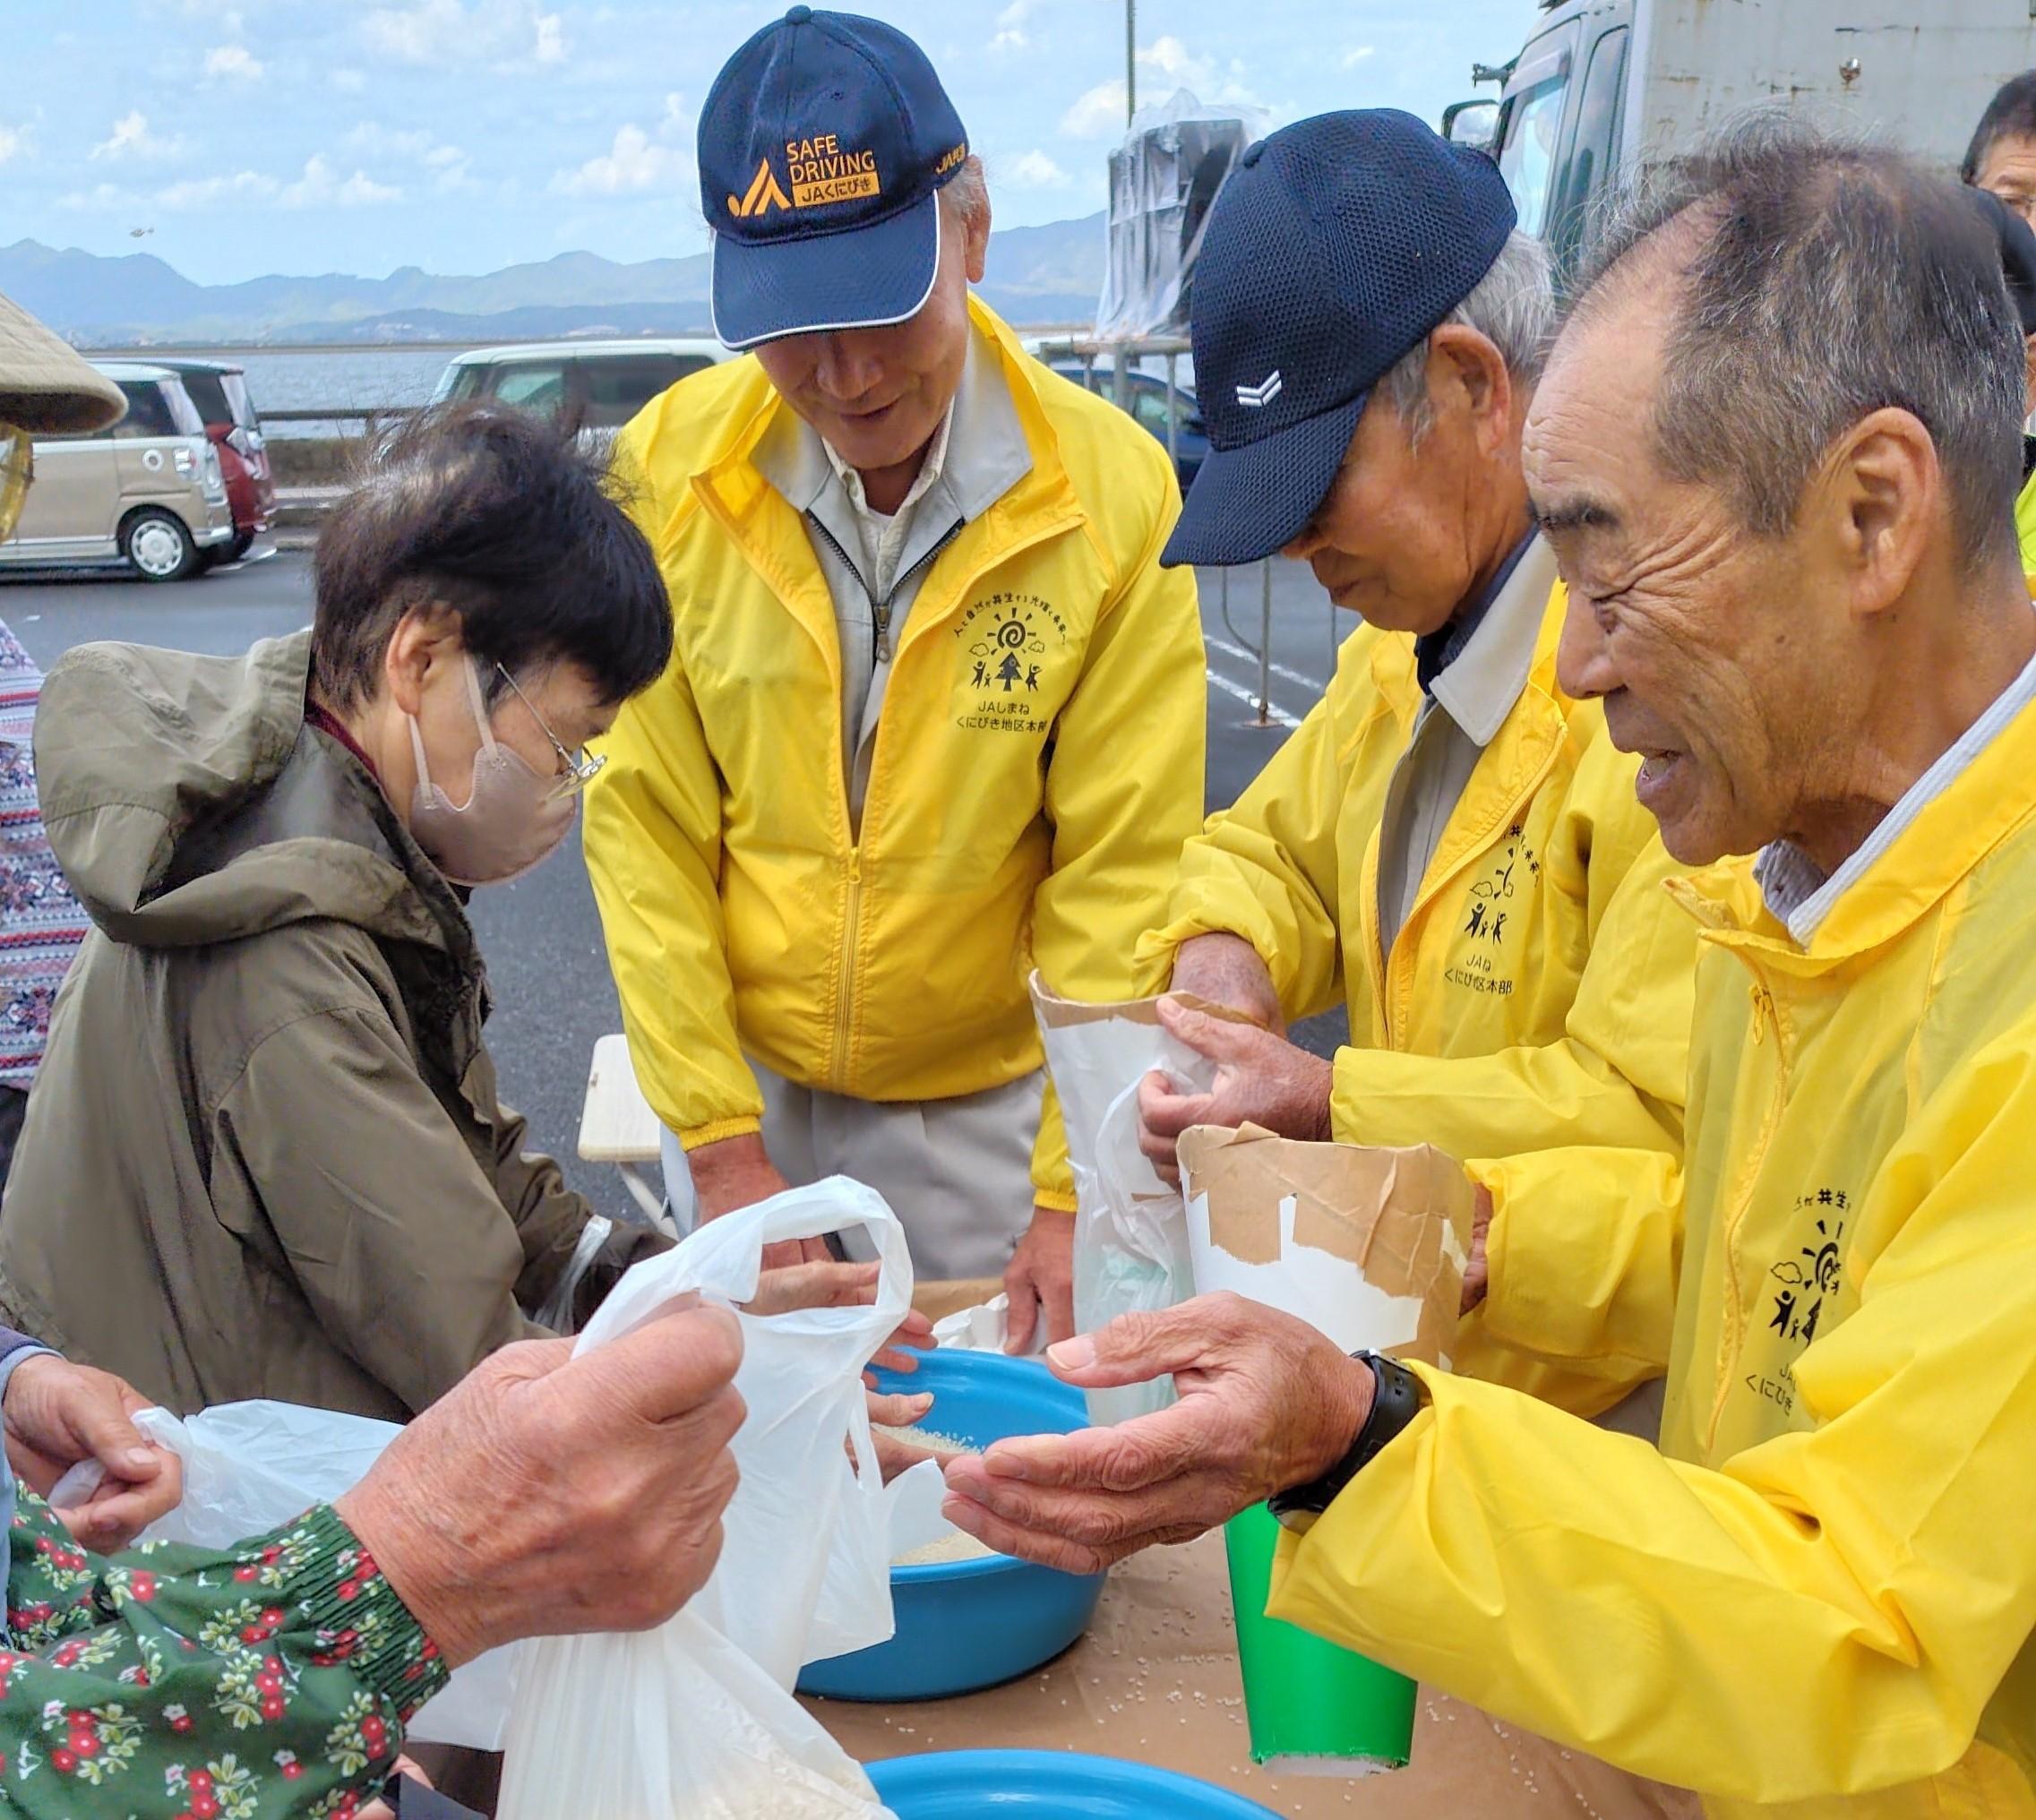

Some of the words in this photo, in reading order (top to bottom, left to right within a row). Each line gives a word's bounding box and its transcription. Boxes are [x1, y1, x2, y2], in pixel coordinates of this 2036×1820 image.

[786, 134, 839, 163] SAFE
[789, 150, 876, 184] DRIVING
[802, 176, 872, 203] JAくにびき
[978, 700, 1030, 715] JAしまね
[956, 717, 1048, 733] くにびき地区本部
